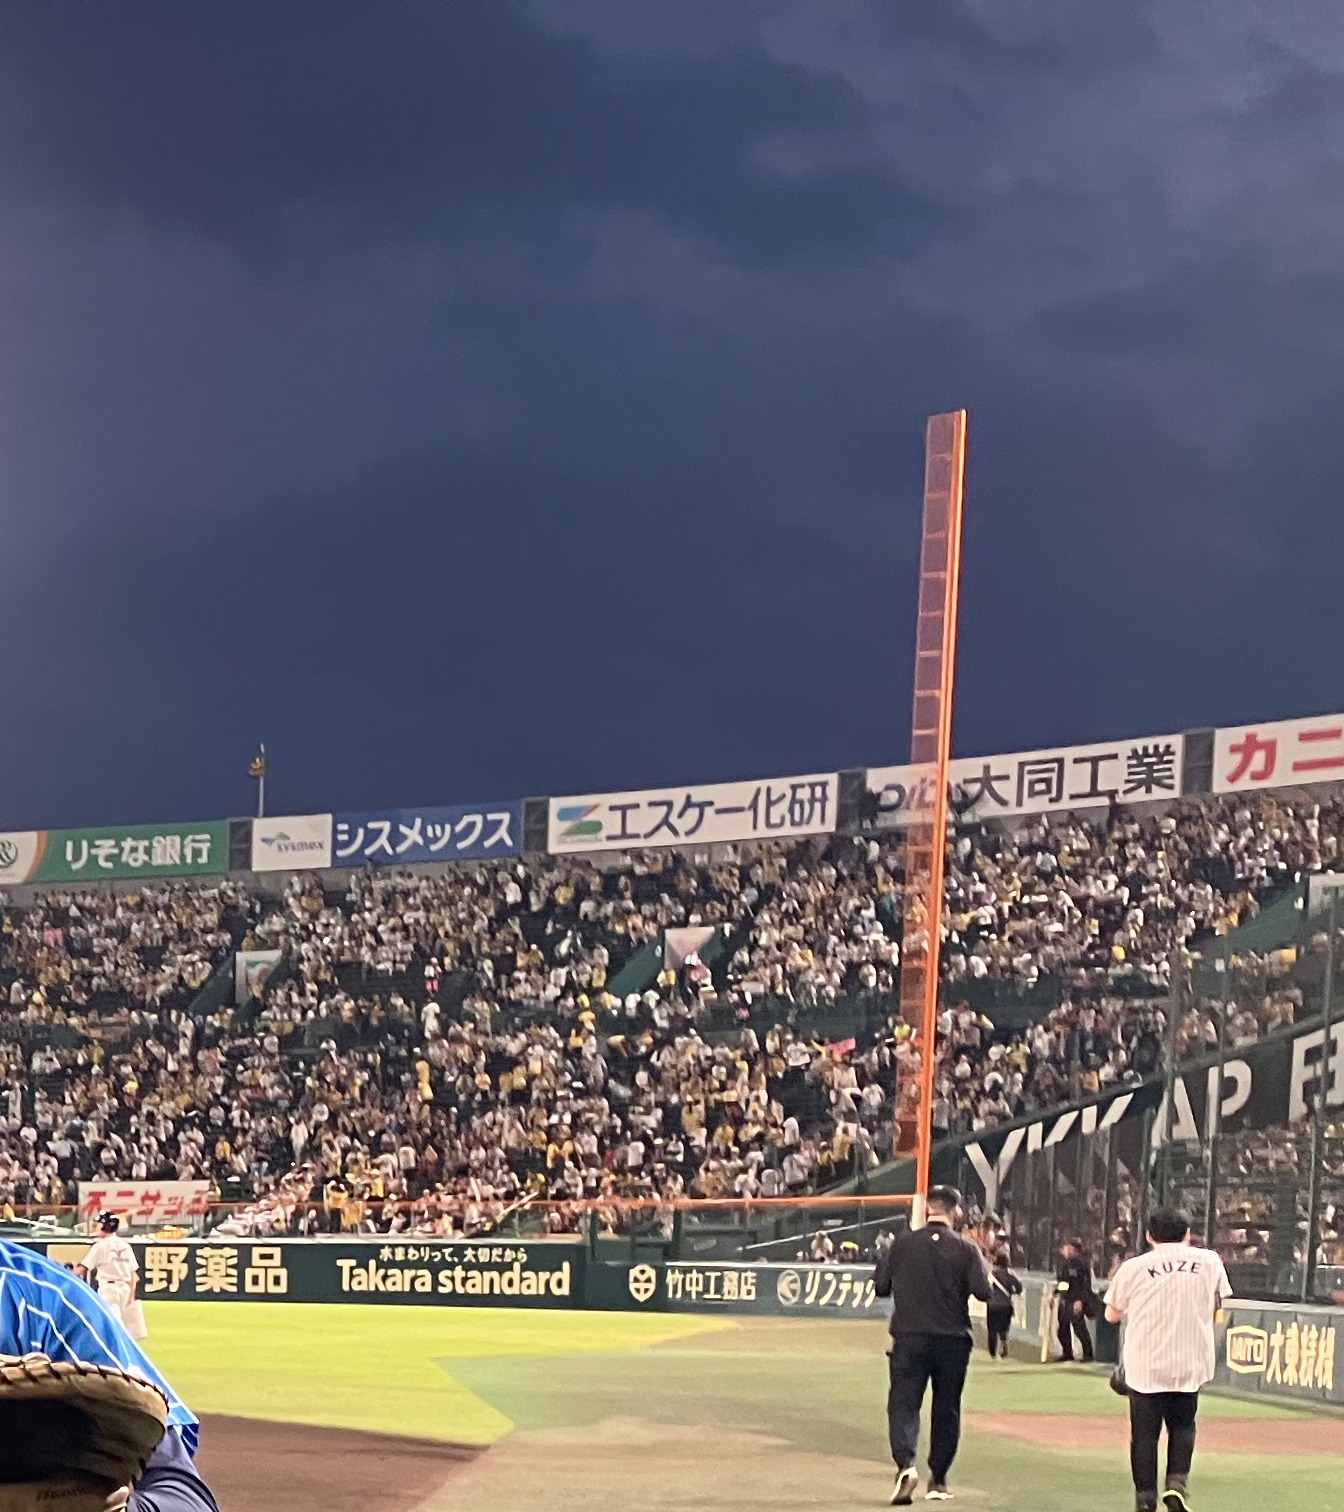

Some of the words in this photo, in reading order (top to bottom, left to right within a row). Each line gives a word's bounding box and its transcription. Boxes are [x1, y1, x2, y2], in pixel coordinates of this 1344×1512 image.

[963, 743, 1177, 809] 大同工業
[607, 779, 829, 841] エスケー化研
[65, 833, 211, 872] りそな銀行
[335, 812, 513, 858] シスメックス
[144, 1247, 288, 1294] 野薬品
[336, 1259, 432, 1293] Takara
[438, 1261, 571, 1296] standard
[666, 1270, 757, 1300] 竹中工務店
[1147, 1261, 1202, 1279] KUZE
